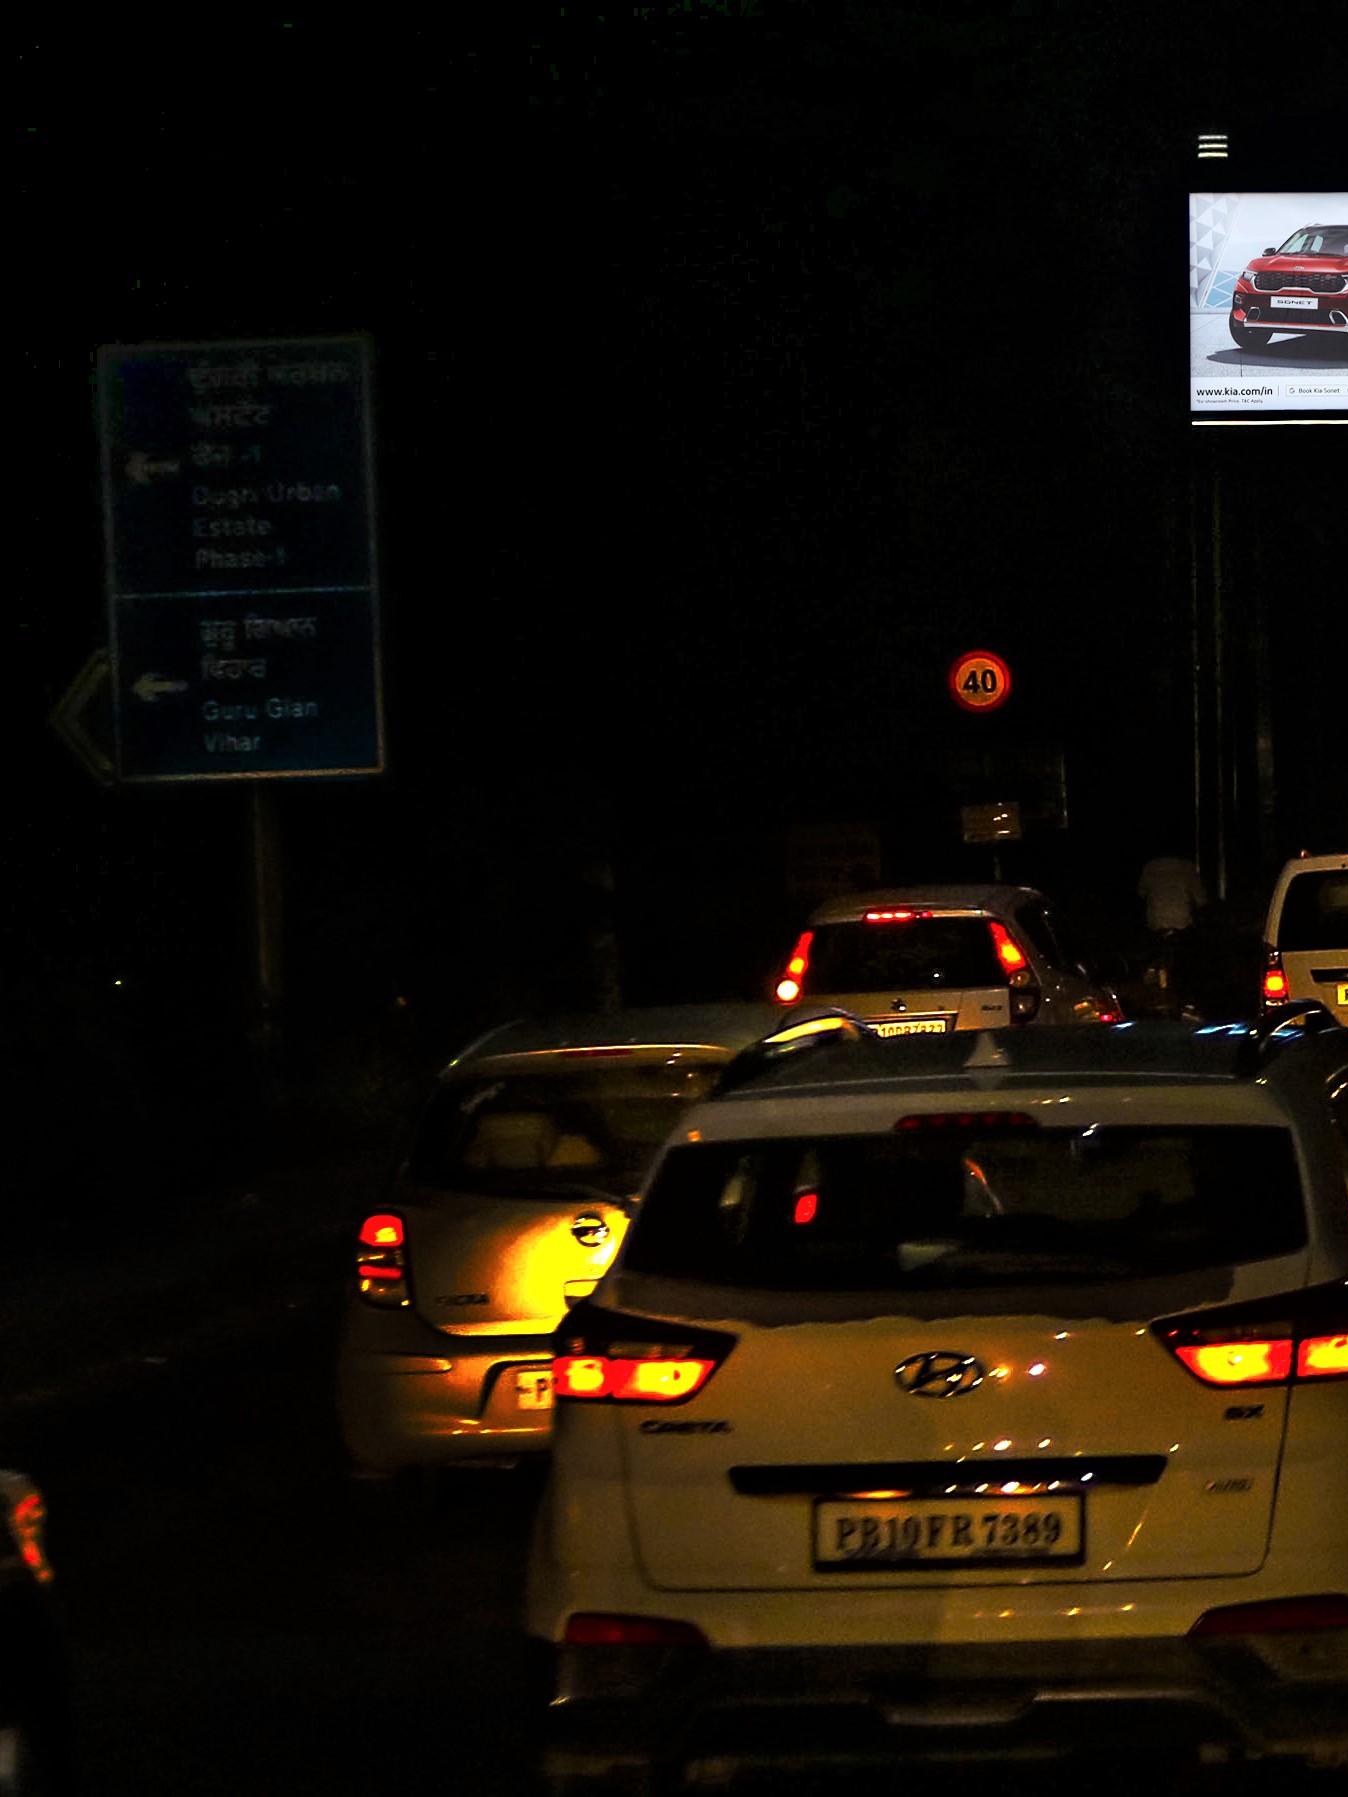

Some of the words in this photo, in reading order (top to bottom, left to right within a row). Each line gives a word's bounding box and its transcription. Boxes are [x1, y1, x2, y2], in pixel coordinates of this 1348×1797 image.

[1196, 386, 1273, 396] www.kia.com/in
[193, 516, 272, 538] Estate
[963, 669, 997, 693] 40
[202, 698, 258, 722] Guru
[264, 697, 319, 721] Gian
[203, 731, 263, 754] Vihar
